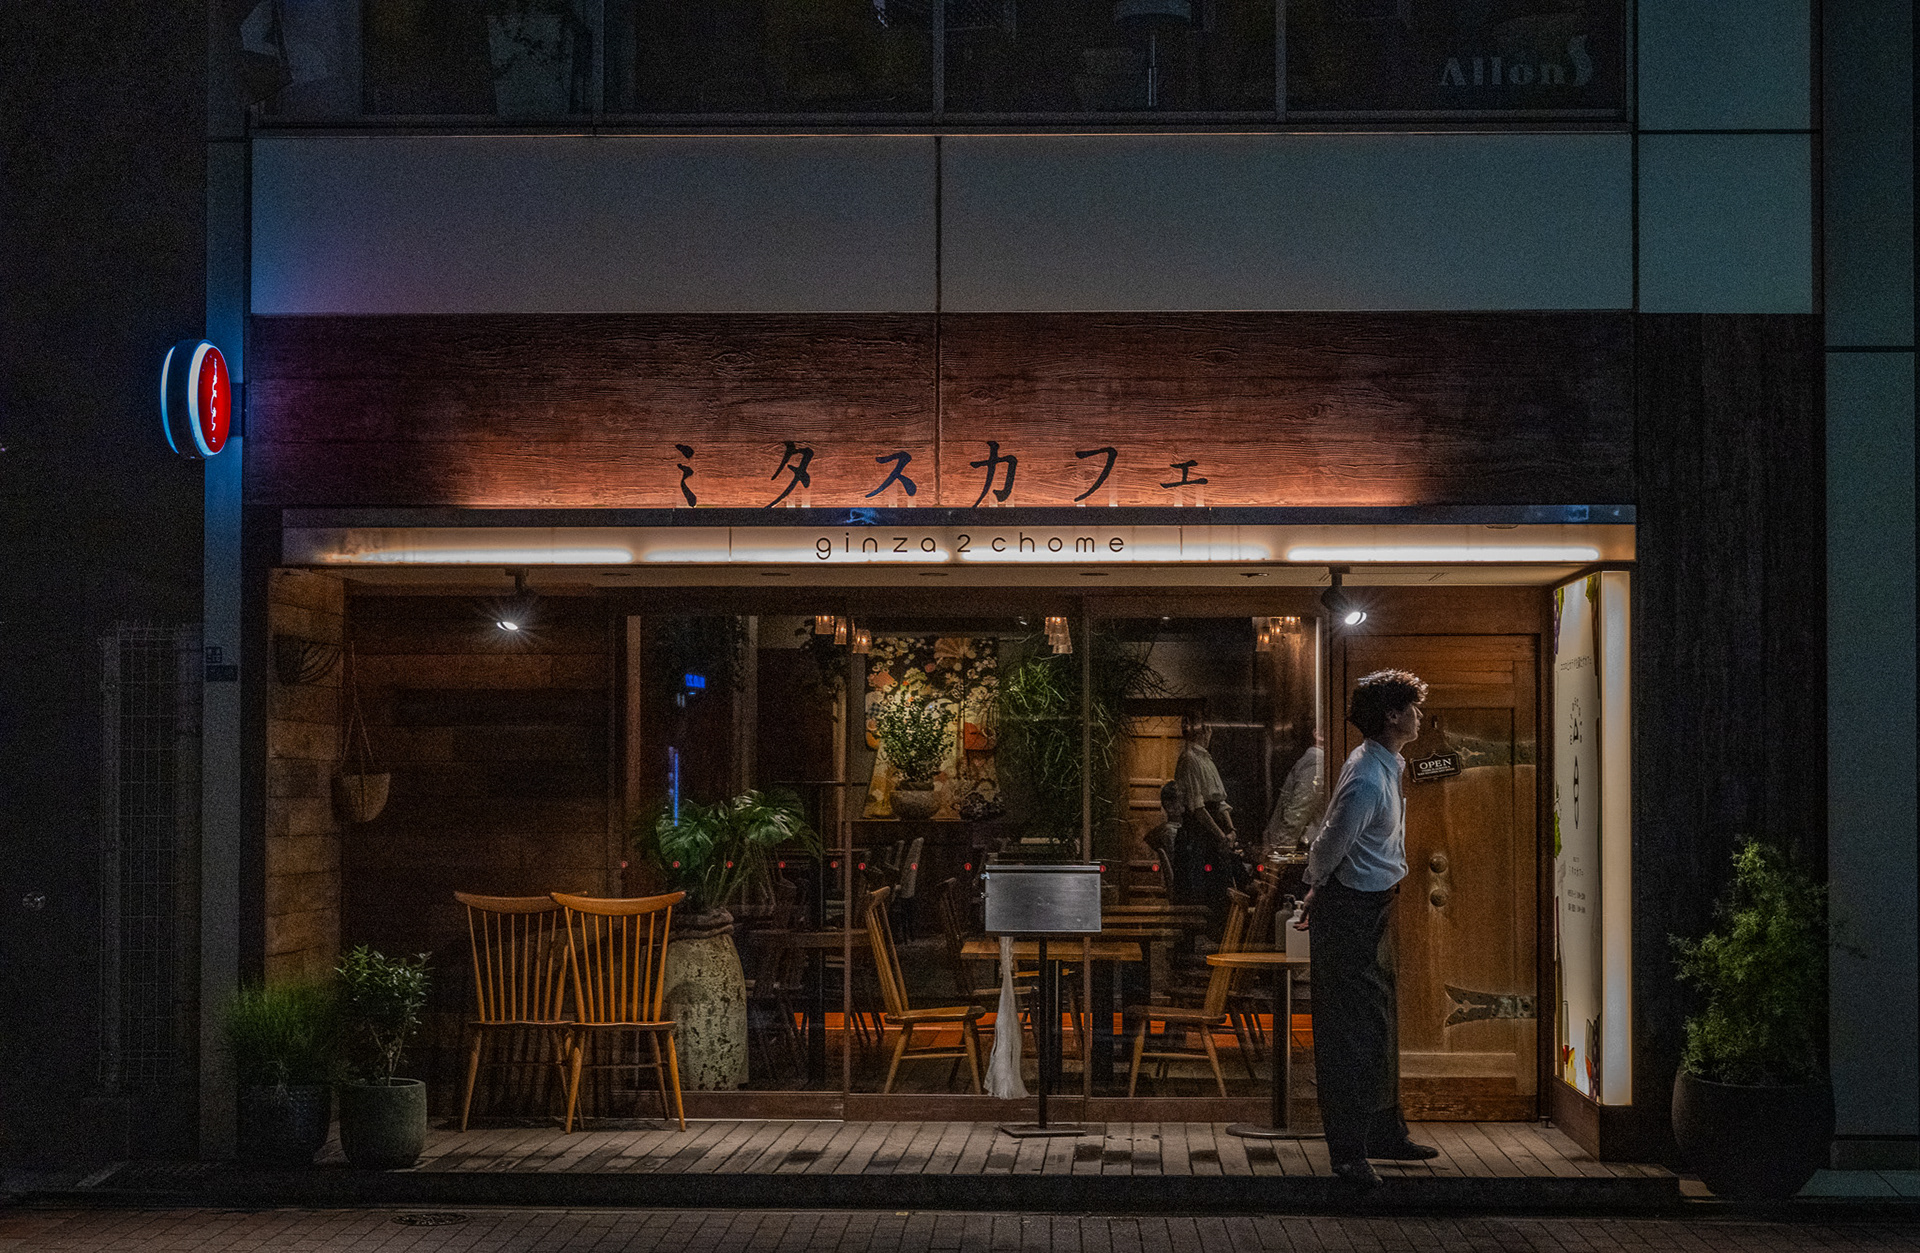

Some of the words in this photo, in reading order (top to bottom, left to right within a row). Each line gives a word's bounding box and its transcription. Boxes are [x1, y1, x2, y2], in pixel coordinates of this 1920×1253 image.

[675, 440, 1209, 510] ミタスカフェ
[816, 531, 938, 560] ginza
[957, 533, 972, 553] 2
[991, 531, 1125, 553] chome
[1419, 758, 1452, 770] OPEN
